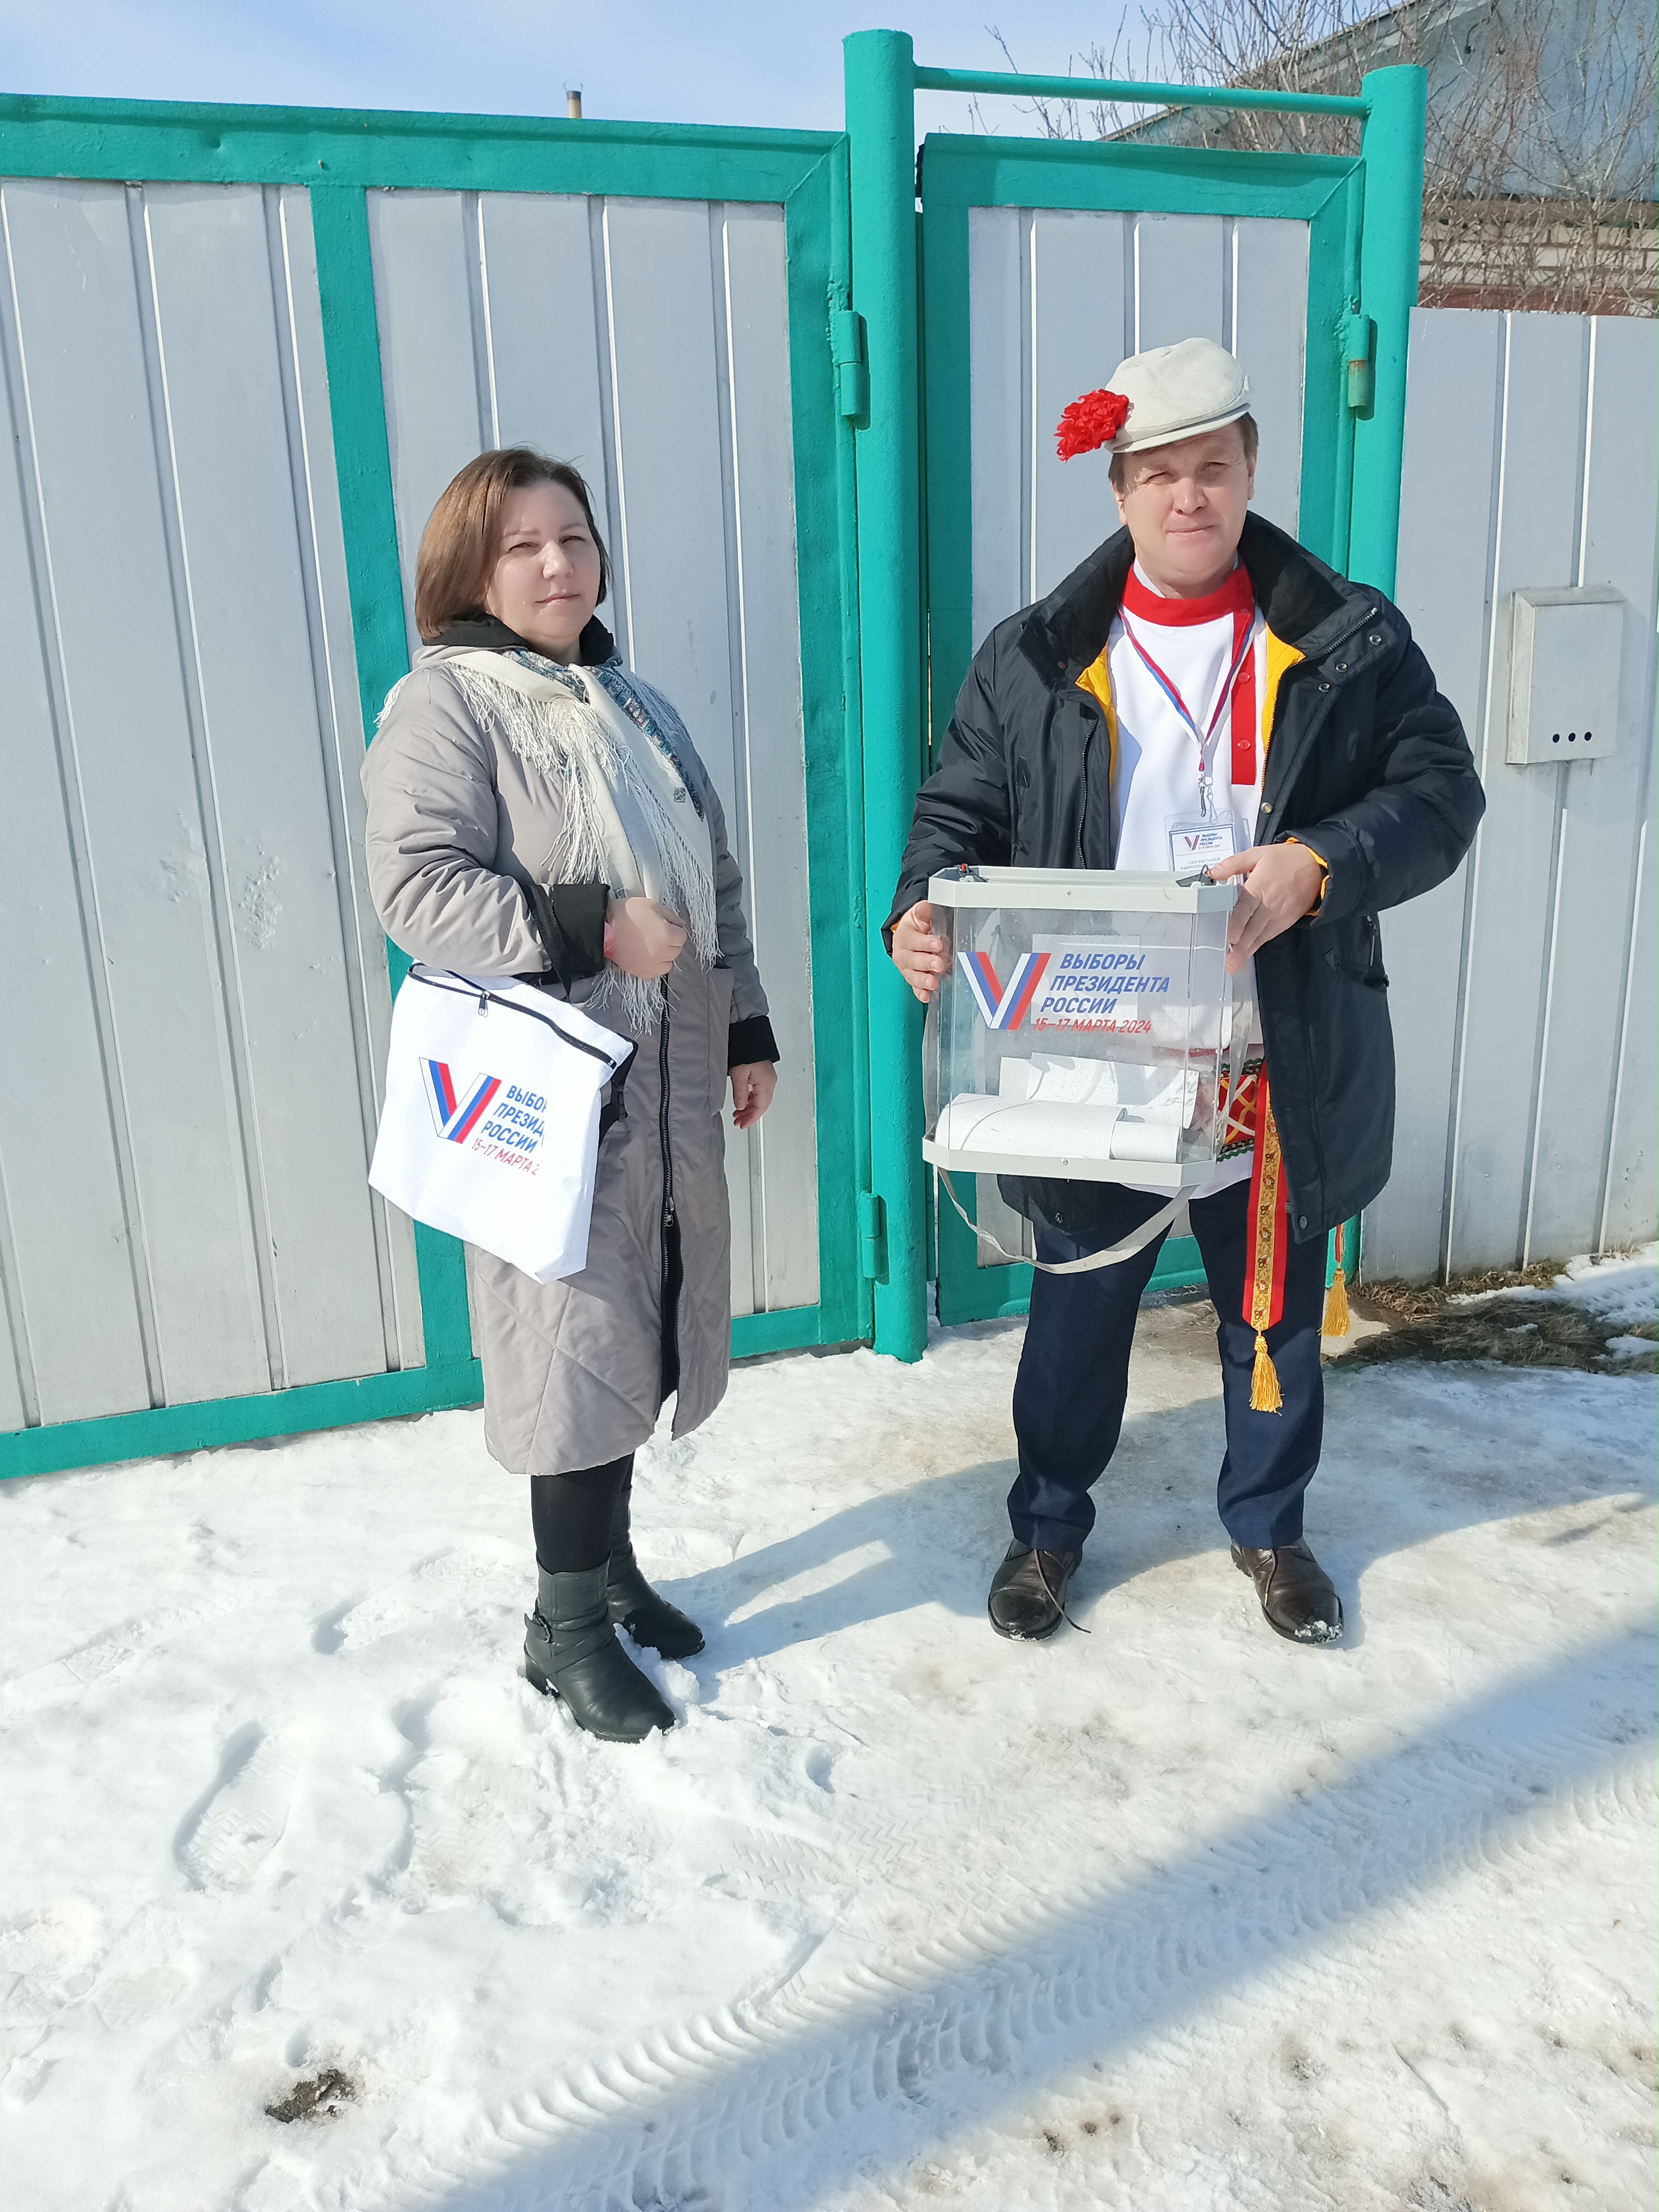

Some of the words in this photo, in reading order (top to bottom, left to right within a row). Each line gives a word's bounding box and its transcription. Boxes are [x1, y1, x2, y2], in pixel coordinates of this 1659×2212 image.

[1059, 953, 1146, 970] ВЫБОРЫ
[1049, 975, 1170, 994] ПРЕЗИДЕНТА
[1040, 997, 1118, 1014] РОССИИ
[1070, 1018, 1116, 1033] МАРТА
[1117, 1019, 1152, 1034] 2024
[481, 1120, 539, 1153] РОССИИ
[494, 1148, 533, 1172] МАРТА
